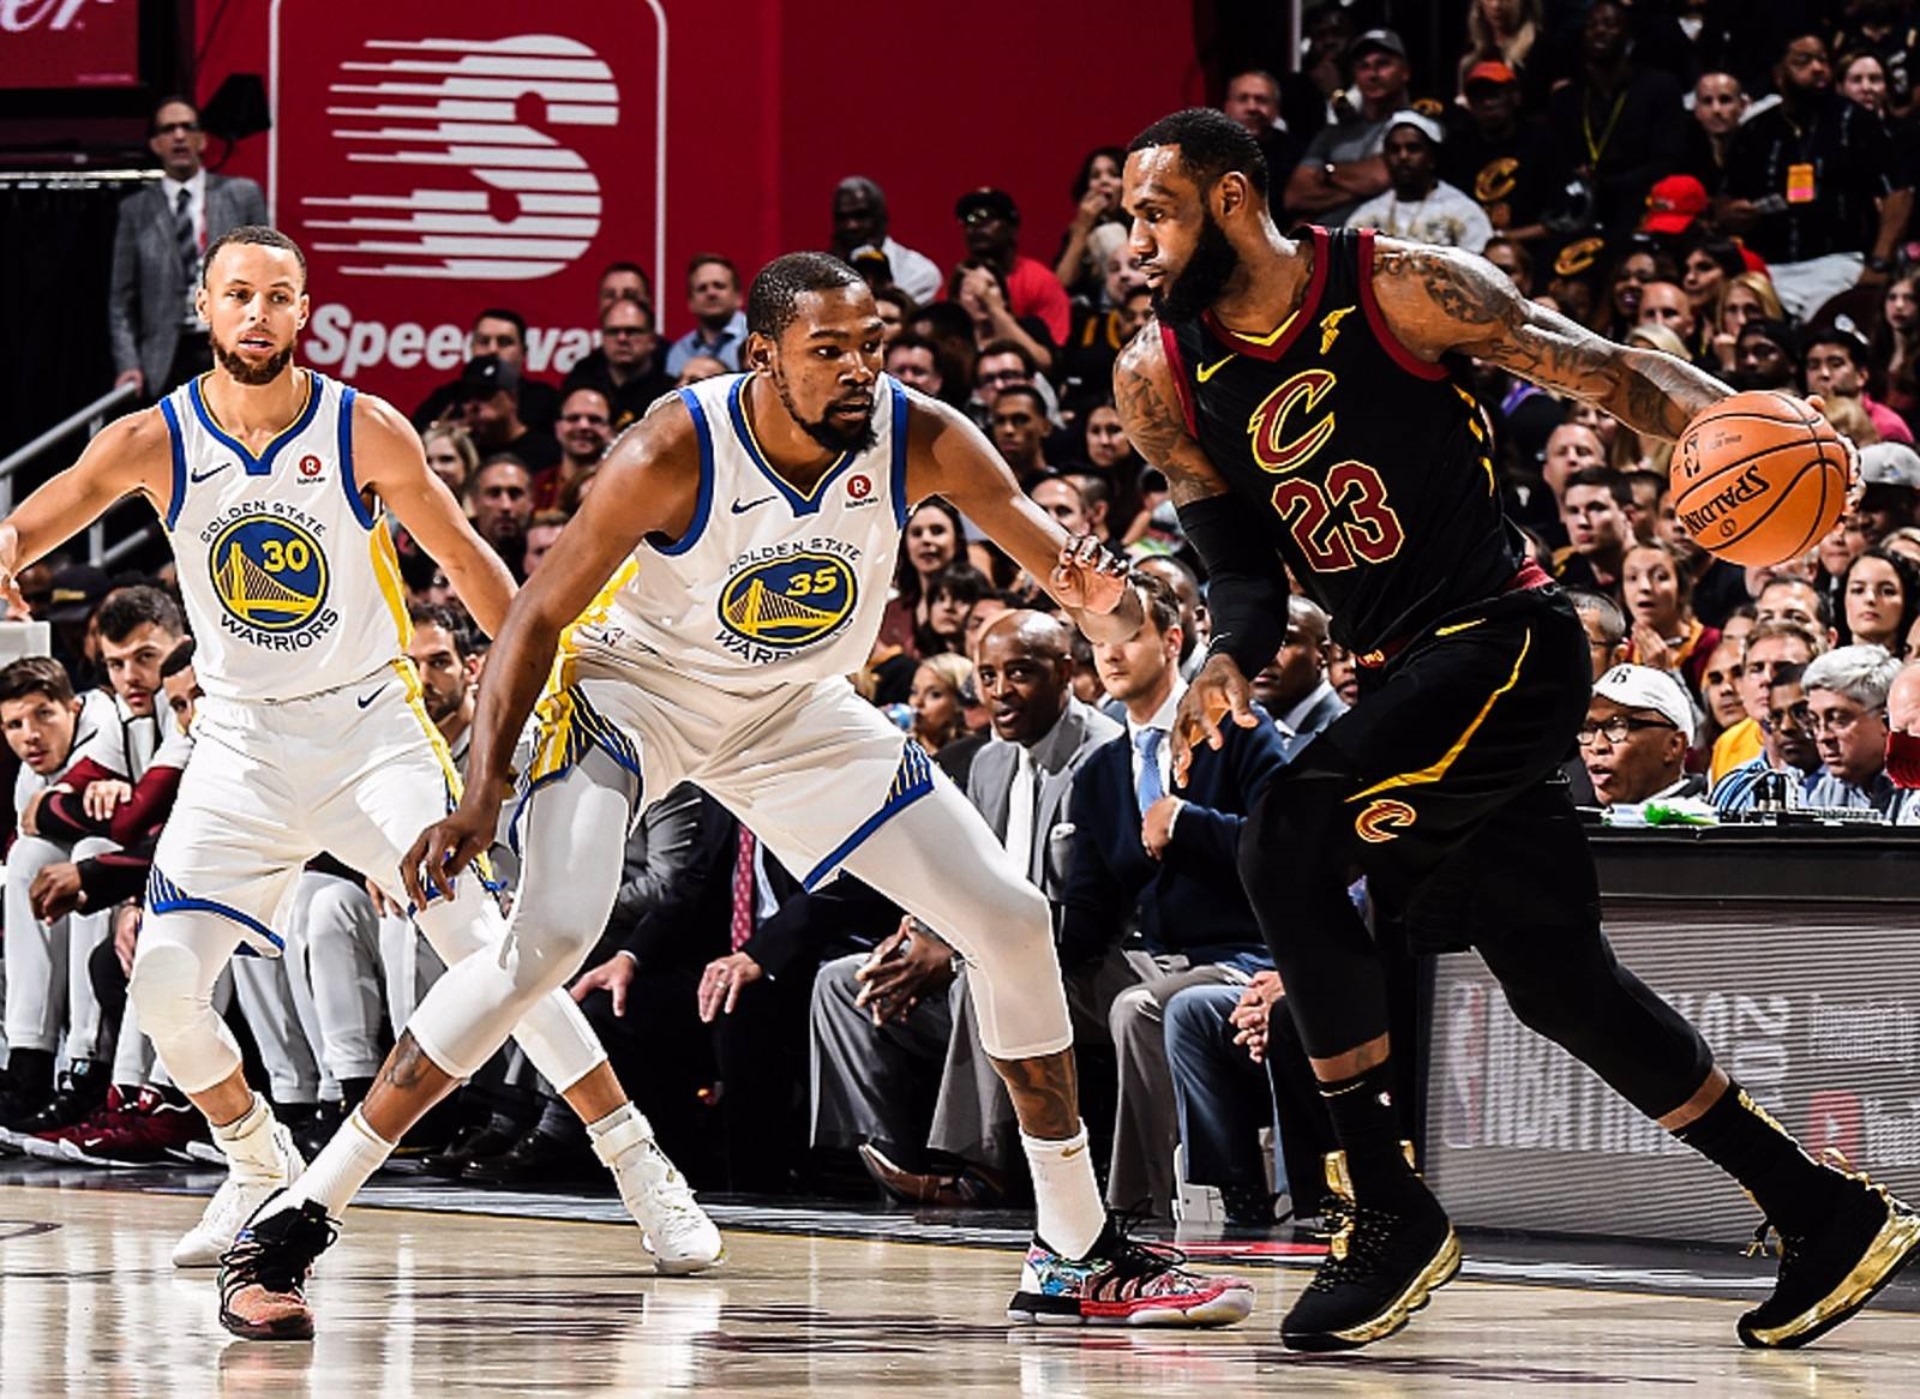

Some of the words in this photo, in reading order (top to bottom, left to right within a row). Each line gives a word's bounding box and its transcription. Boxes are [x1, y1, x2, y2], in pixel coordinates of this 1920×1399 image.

[200, 500, 267, 544] GOLDEN
[273, 502, 327, 538] STATE
[1271, 459, 1405, 573] 23
[261, 538, 311, 573] 30
[810, 537, 863, 561] STATE
[785, 565, 838, 597] 35
[219, 607, 339, 653] WARRIORS
